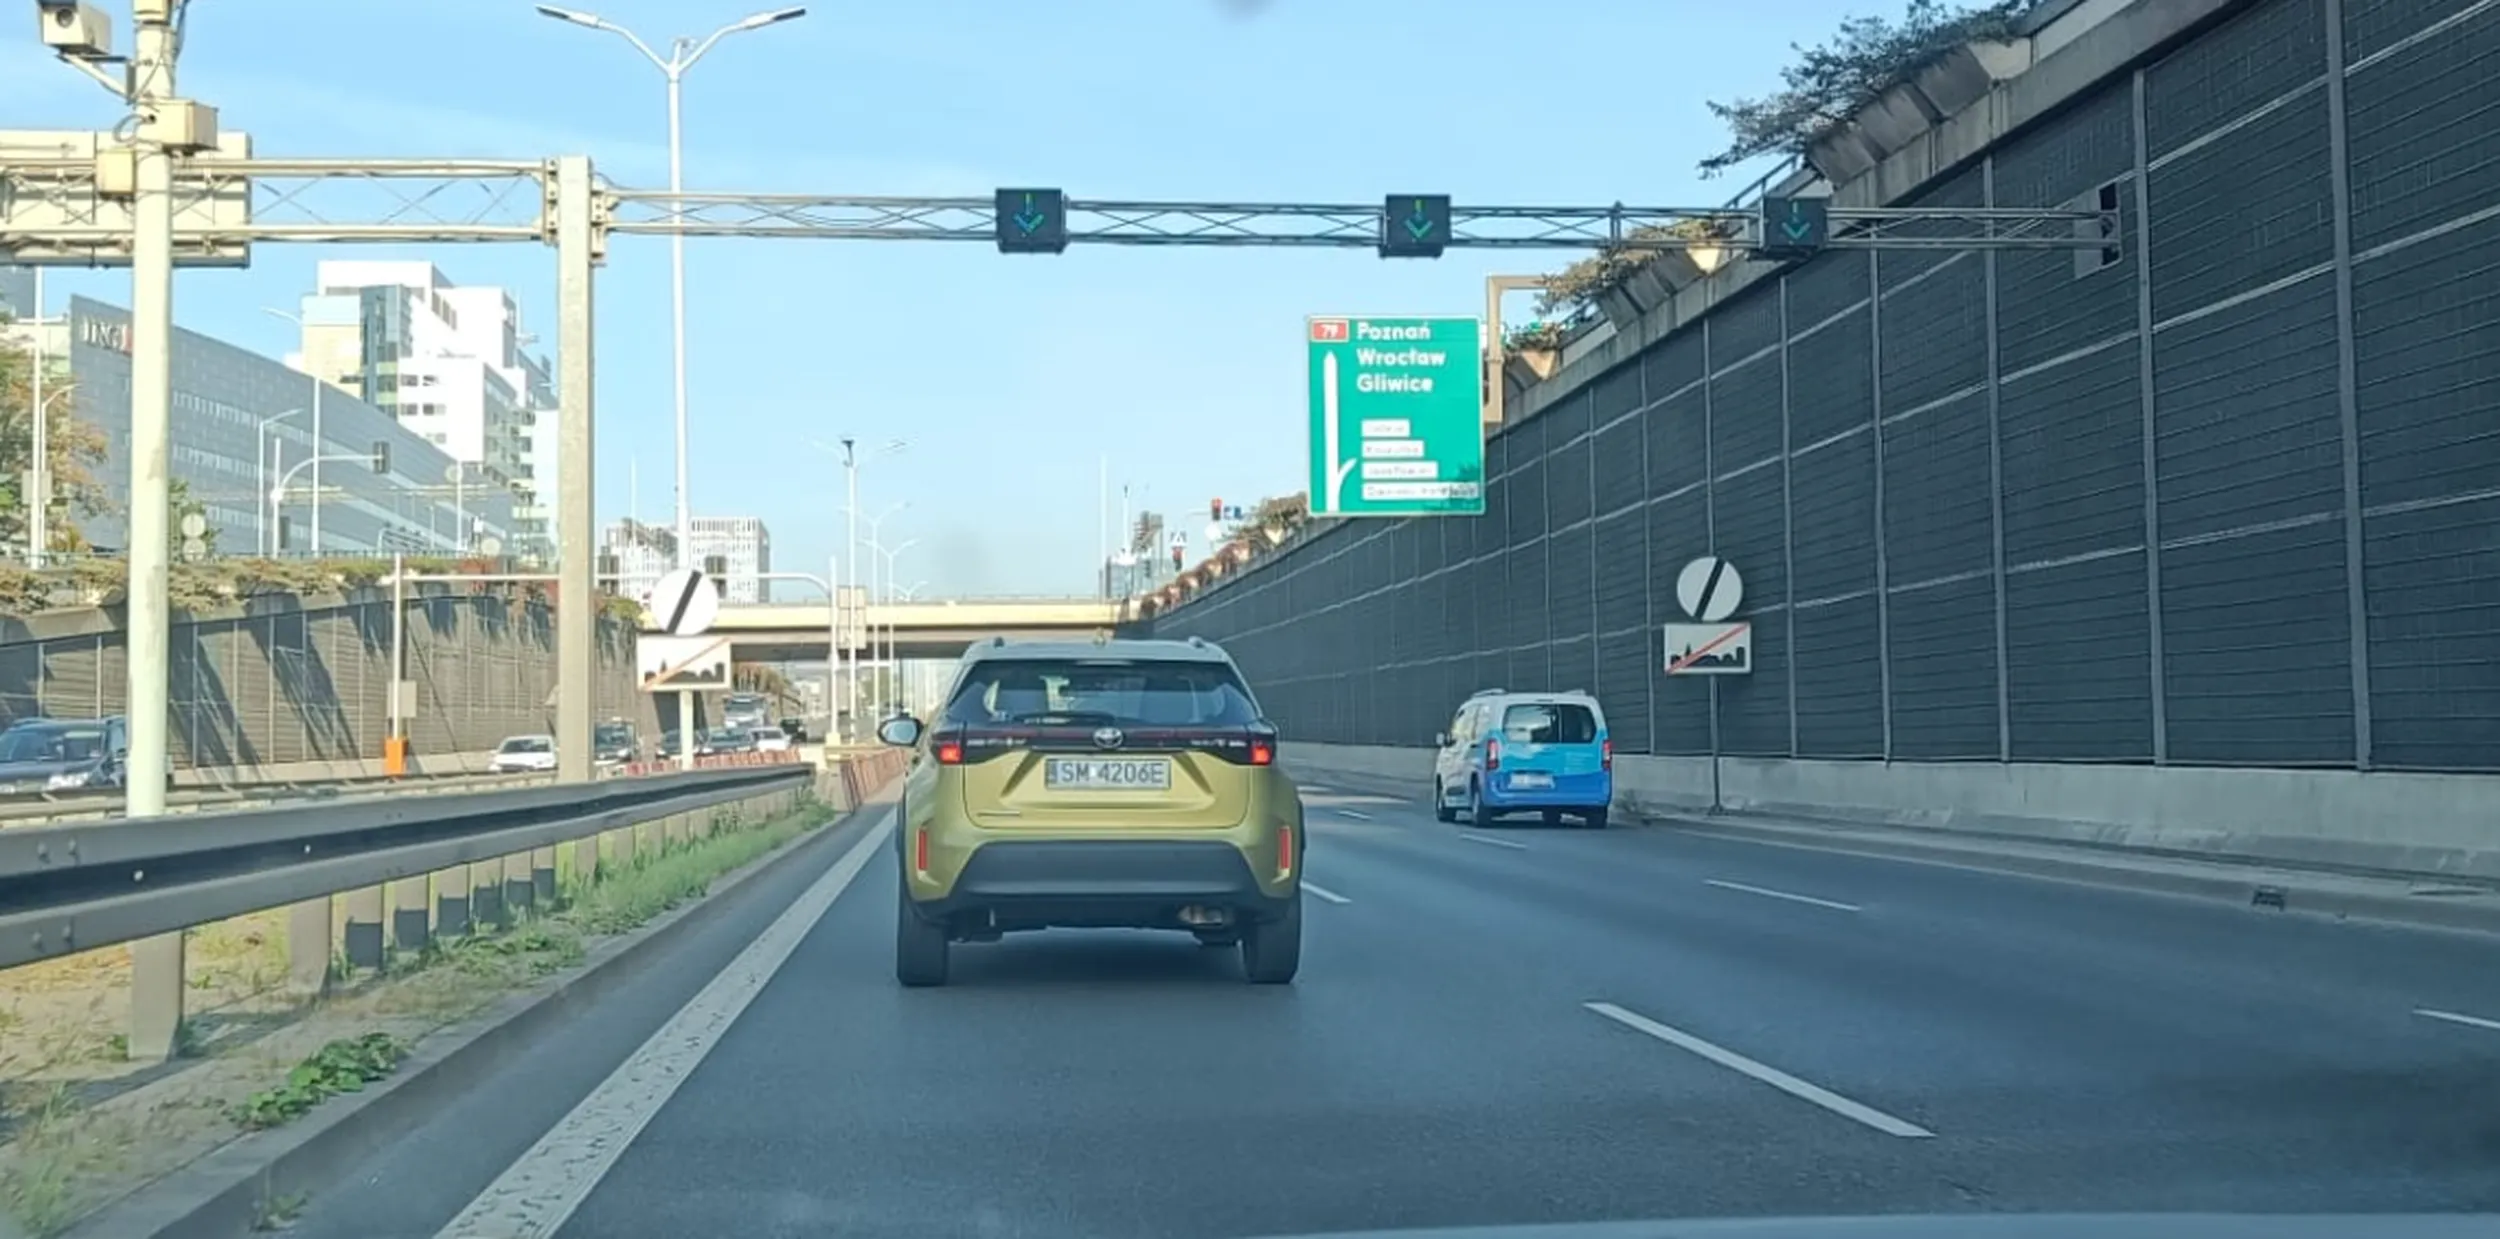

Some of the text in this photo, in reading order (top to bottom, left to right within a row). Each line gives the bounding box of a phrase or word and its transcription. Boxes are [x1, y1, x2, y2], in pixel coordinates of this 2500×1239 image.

[1320, 324, 1339, 338] 79
[1356, 321, 1431, 340] Poznań
[1356, 348, 1446, 366] Wrocław
[1356, 374, 1434, 393] Gliwice
[1060, 760, 1090, 783] SM
[1098, 759, 1164, 784] 4206E
